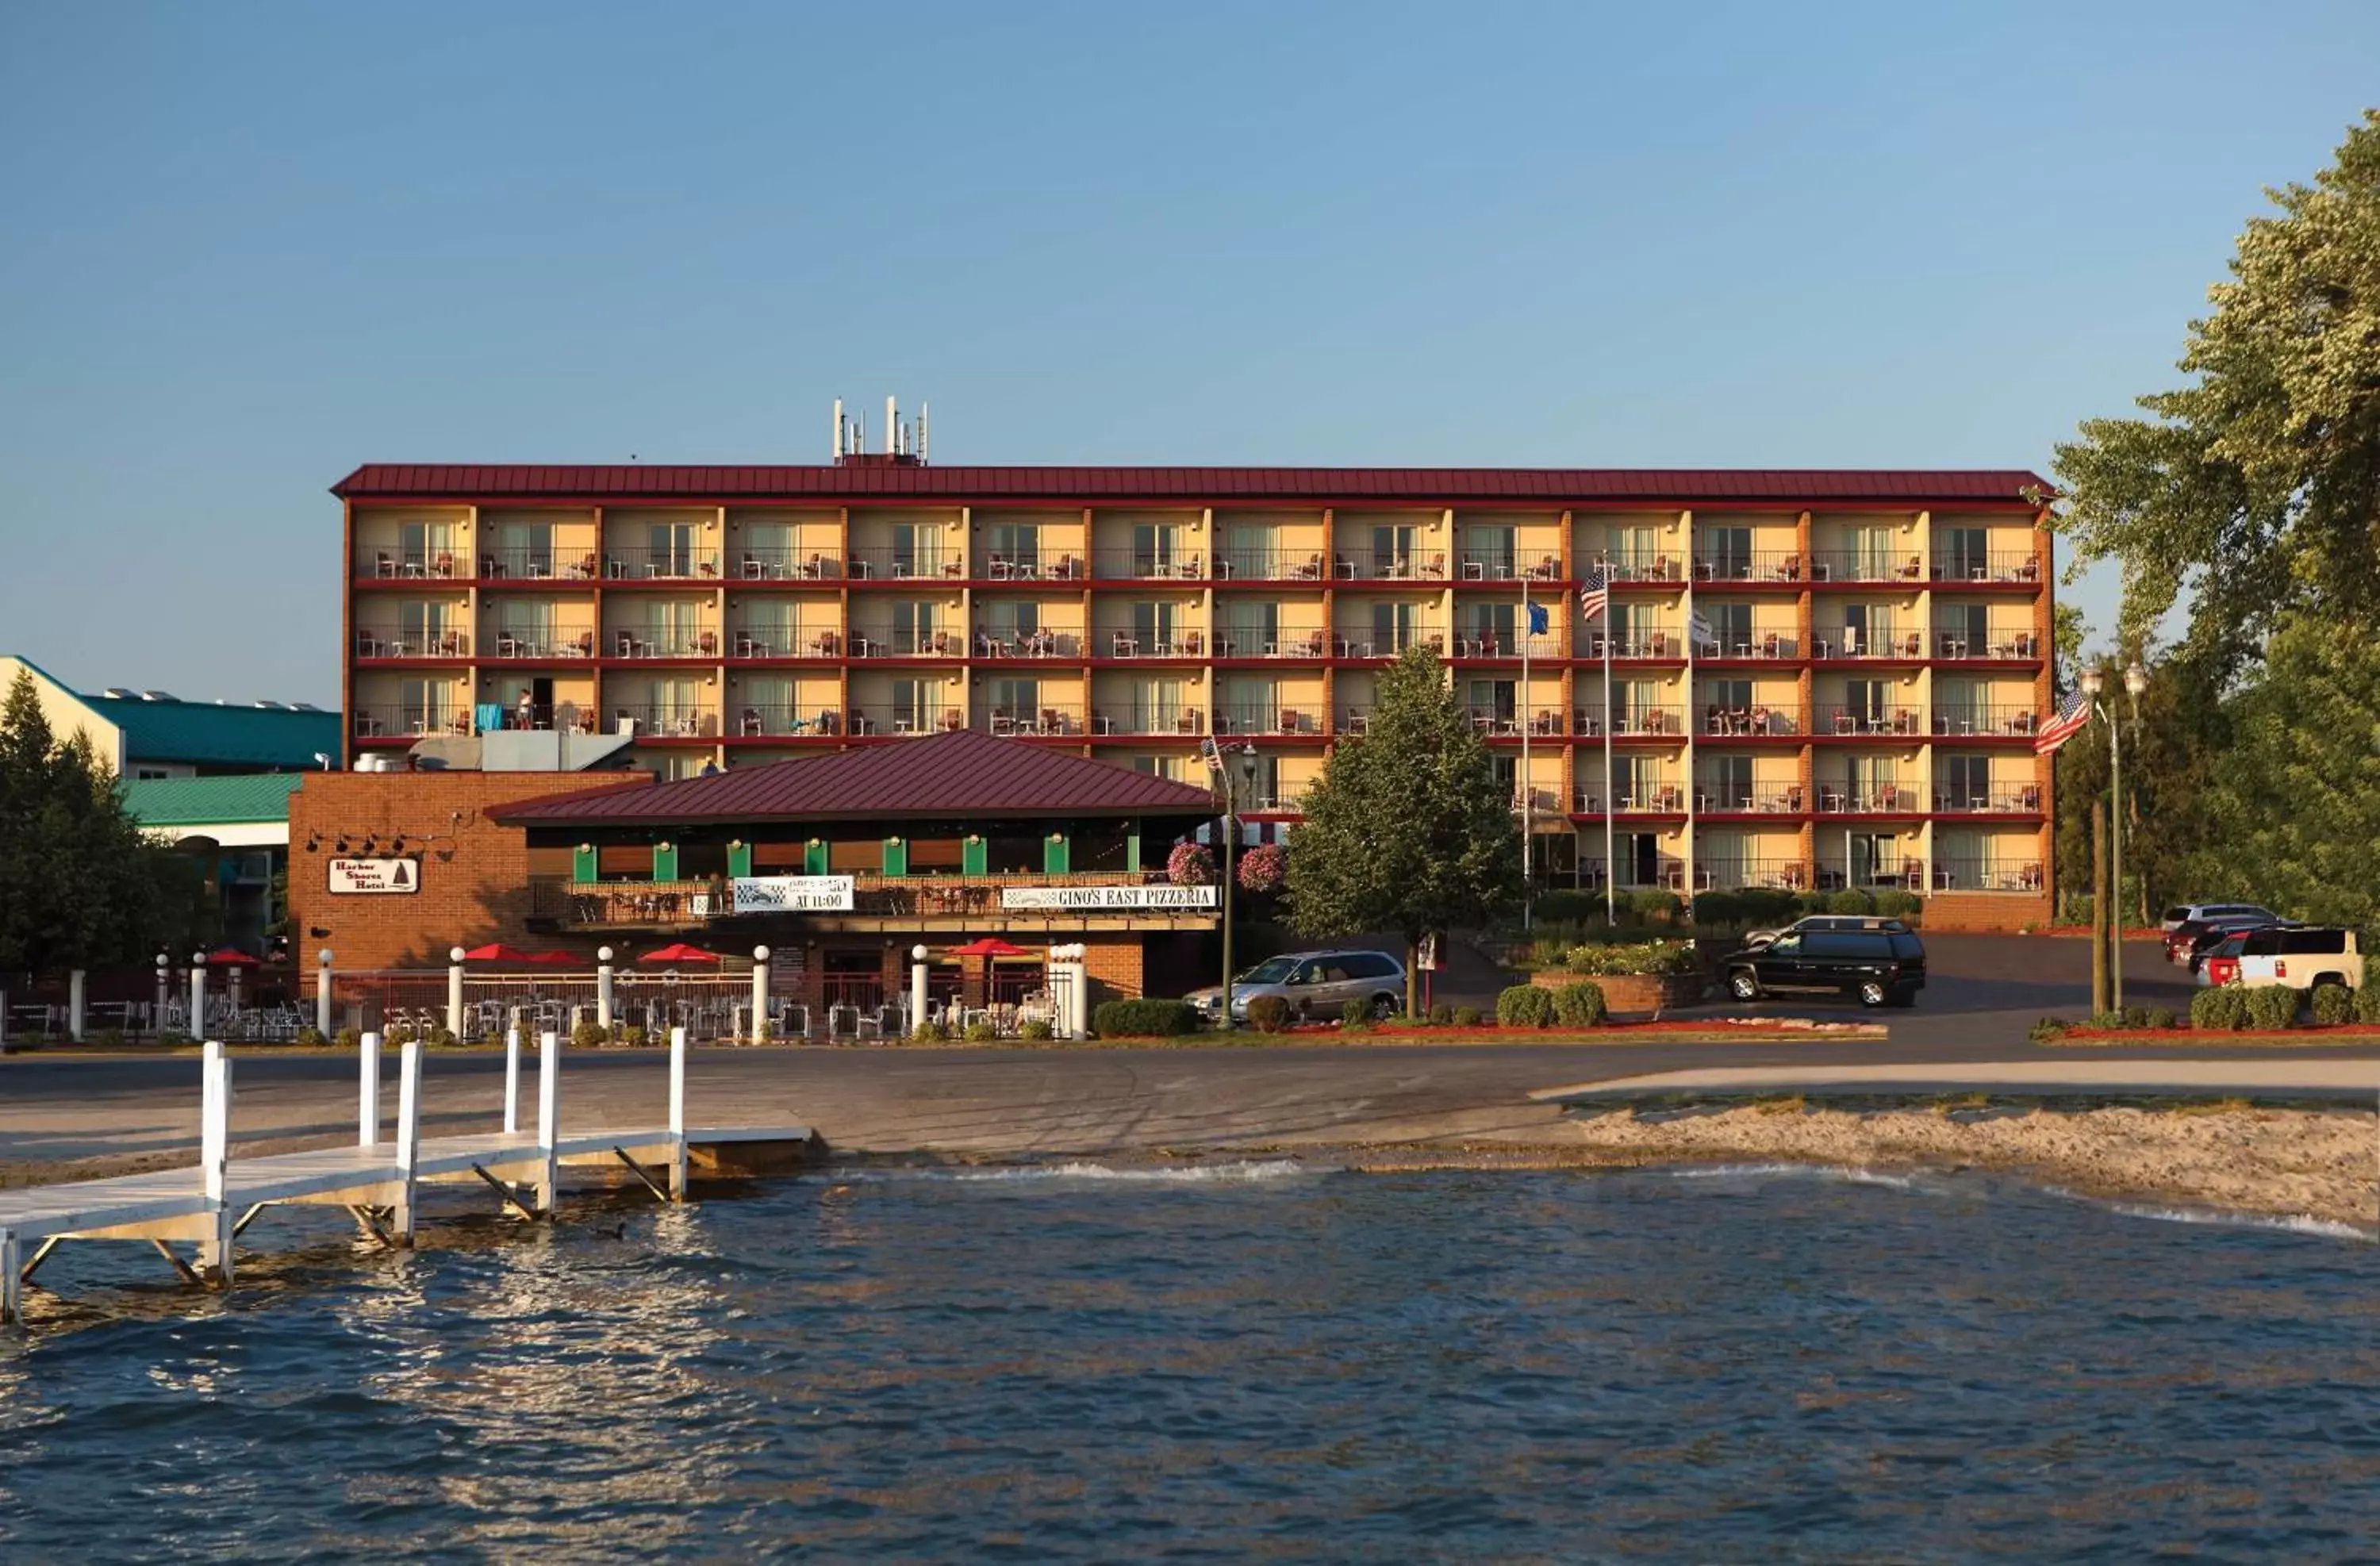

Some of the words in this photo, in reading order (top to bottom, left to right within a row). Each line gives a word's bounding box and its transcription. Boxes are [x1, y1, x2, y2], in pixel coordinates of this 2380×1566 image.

[796, 895, 809, 908] AT
[812, 895, 842, 908] 11:00
[1059, 889, 1100, 904] GINO'S
[1107, 889, 1142, 904] EAST
[1146, 889, 1210, 904] PIZZERIA
